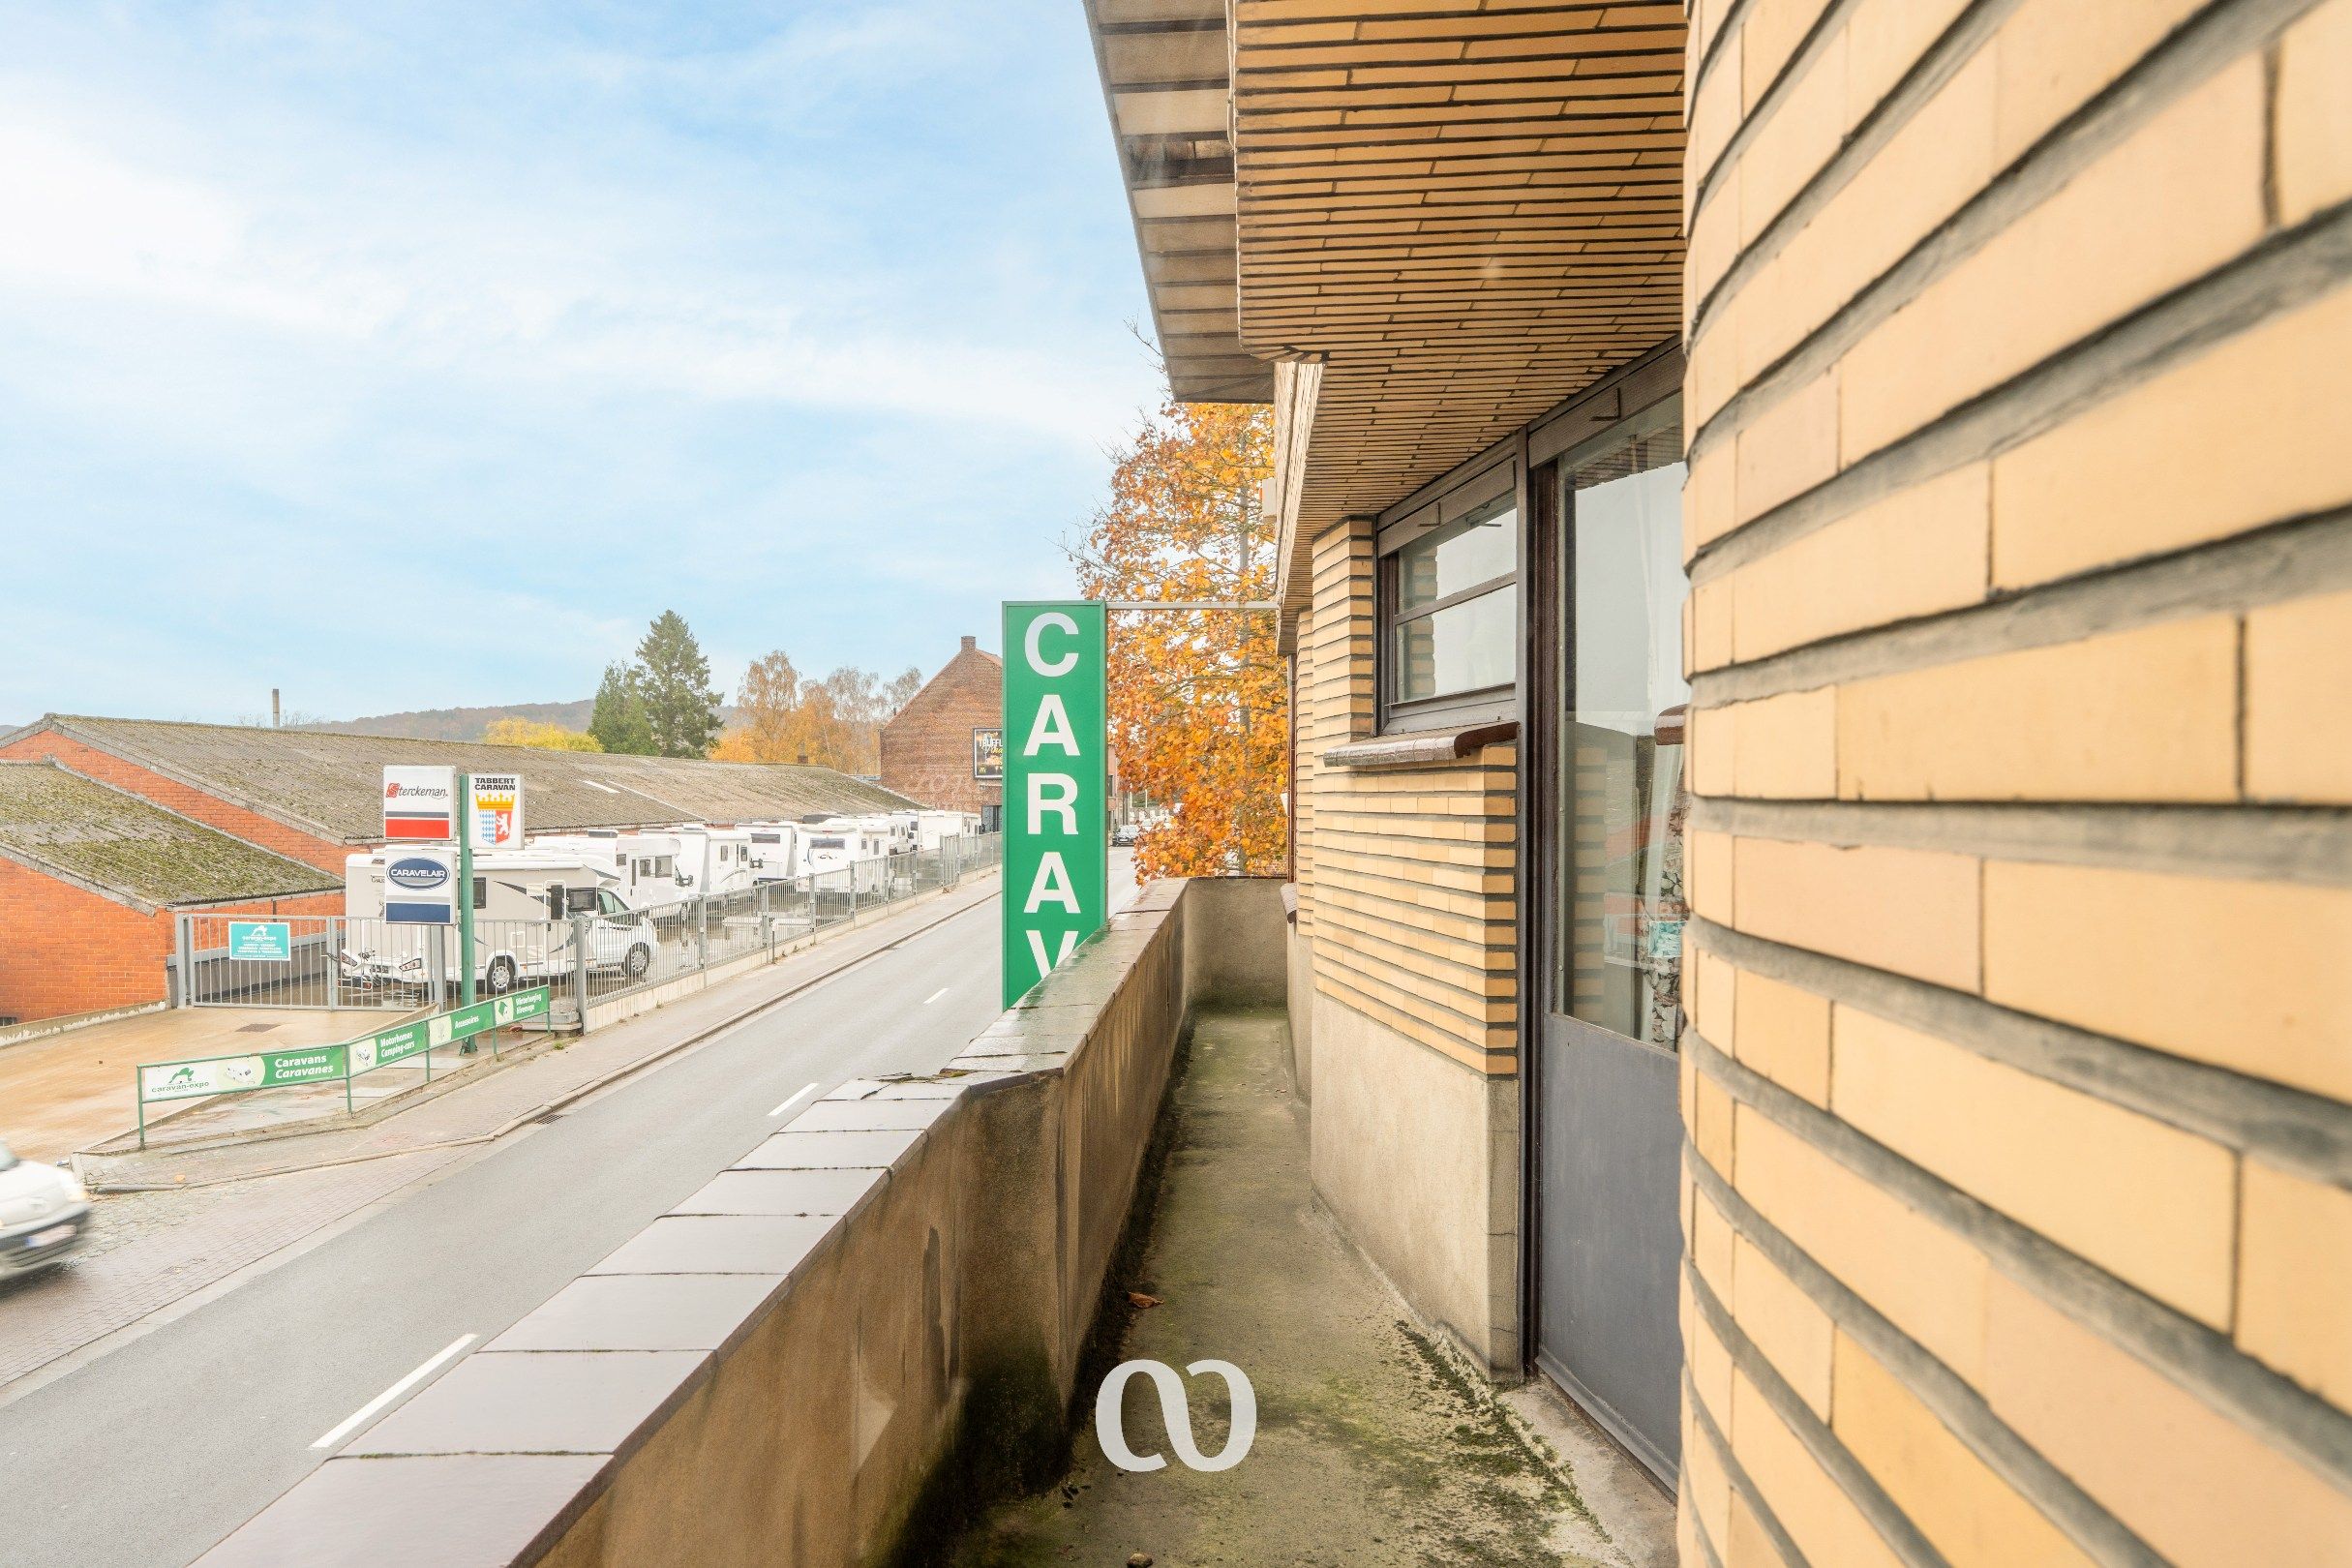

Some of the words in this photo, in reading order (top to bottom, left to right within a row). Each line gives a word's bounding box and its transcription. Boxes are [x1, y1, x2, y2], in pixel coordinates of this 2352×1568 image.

[1023, 612, 1081, 980] CARAV
[390, 868, 446, 878] CARAVELAIR
[454, 1015, 480, 1030] Accessoires
[379, 1031, 413, 1048] Motorhomes
[380, 1040, 415, 1058] Camping-cars
[274, 1054, 327, 1069] Caravans
[275, 1063, 334, 1079] Caravanes
[151, 1080, 210, 1093] caravan-expo
